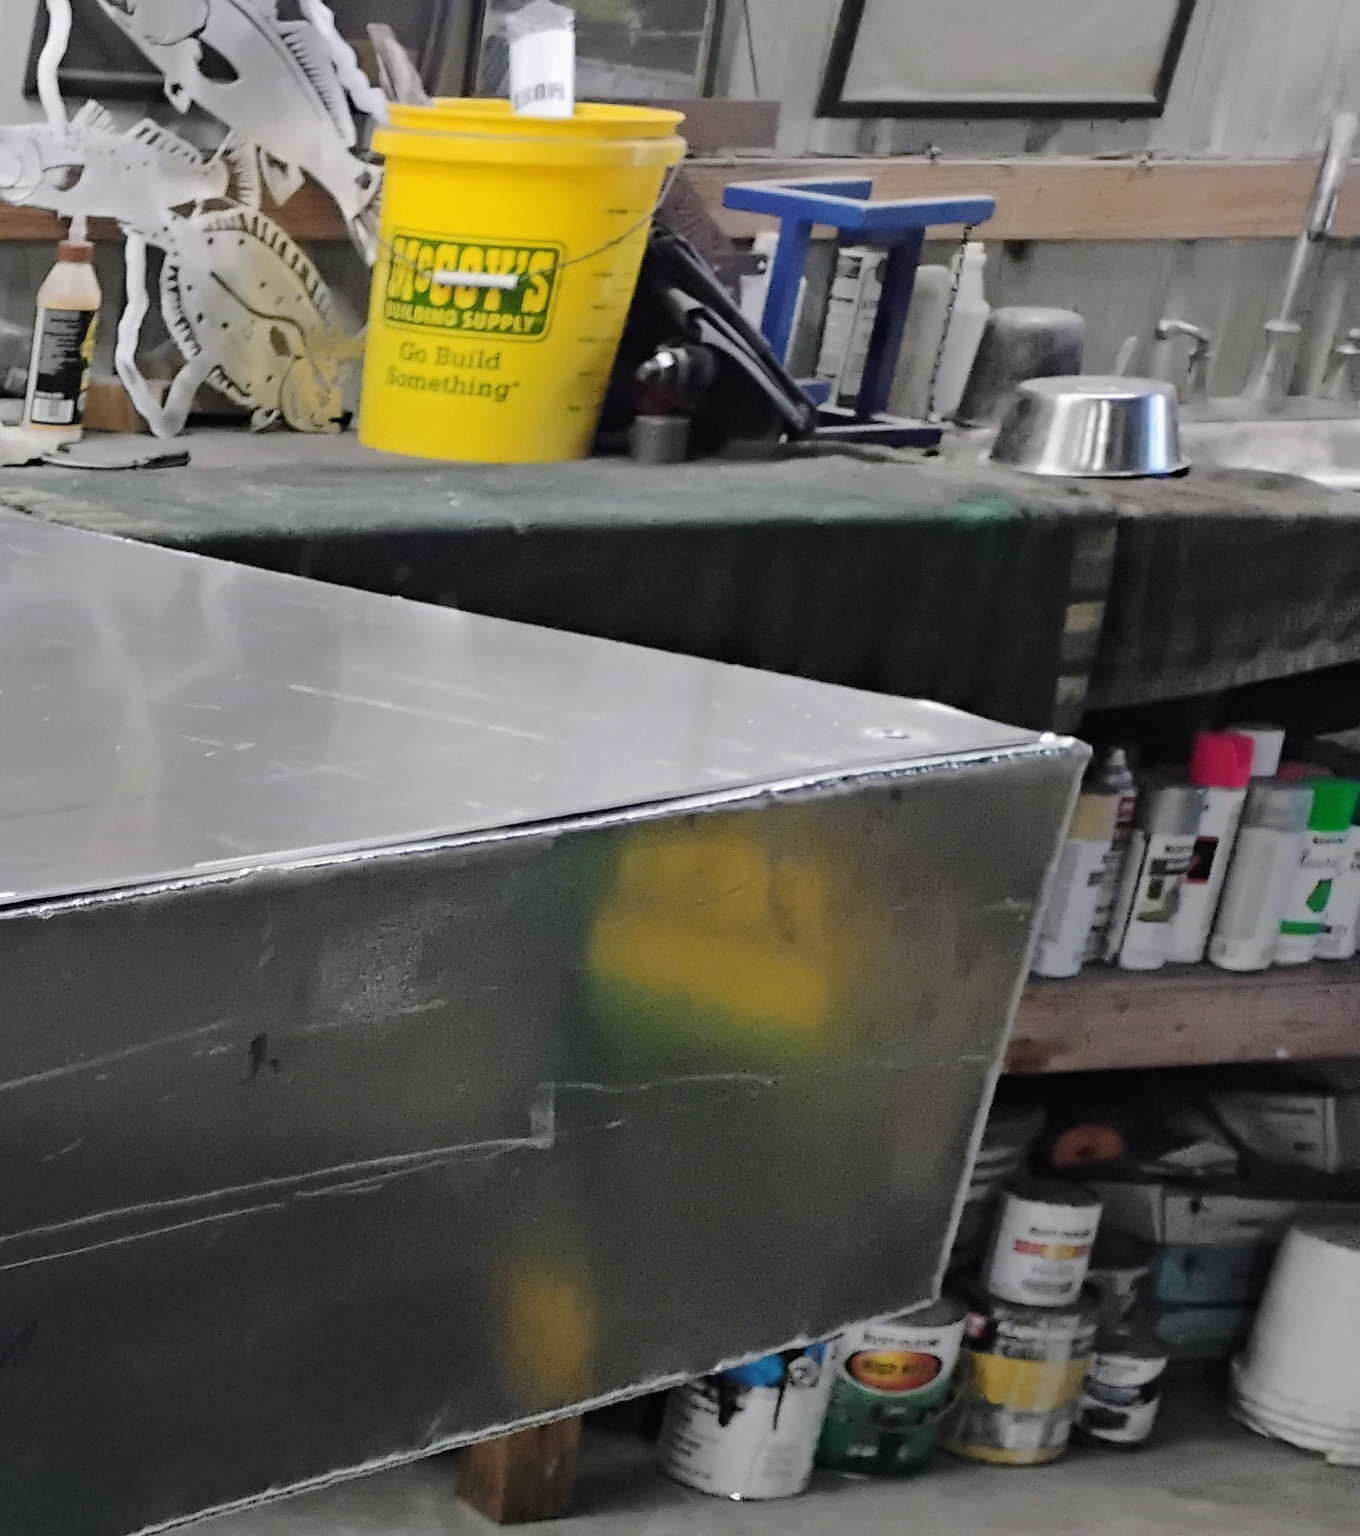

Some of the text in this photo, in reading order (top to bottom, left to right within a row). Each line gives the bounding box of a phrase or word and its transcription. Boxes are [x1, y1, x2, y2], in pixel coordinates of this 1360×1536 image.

[461, 309, 538, 334] SUPPLY
[399, 341, 502, 371] Go Build
